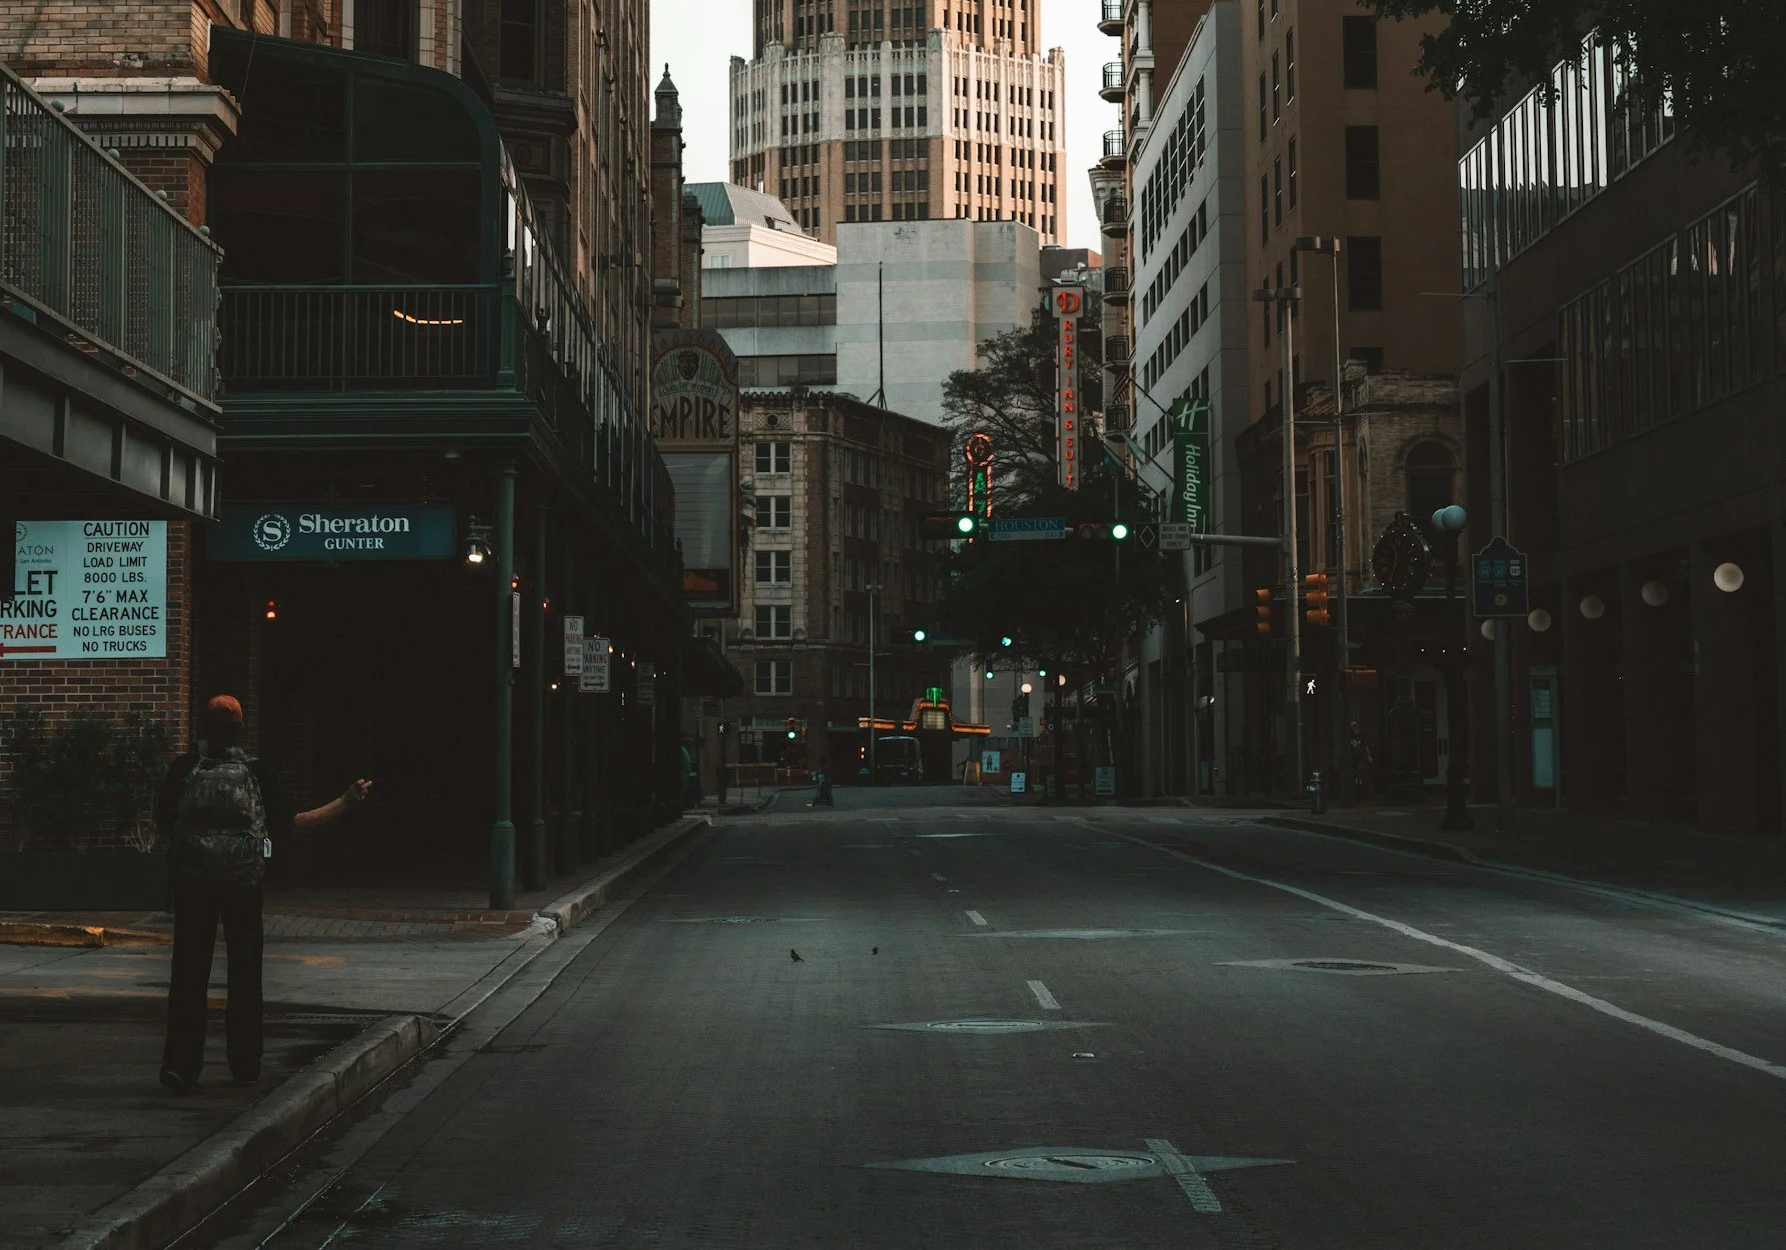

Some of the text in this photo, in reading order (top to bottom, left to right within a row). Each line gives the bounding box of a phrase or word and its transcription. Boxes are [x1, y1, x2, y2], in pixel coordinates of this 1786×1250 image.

[1056, 291, 1081, 371] DRURY
[1063, 377, 1075, 413] INN
[1064, 435, 1076, 492] SUIT
[1183, 444, 1201, 502] Holiday
[84, 522, 149, 537] CAUTION
[299, 514, 411, 534] Sheraton
[995, 518, 1058, 532] HOUSTON
[87, 542, 144, 553] DRIVEWAY
[324, 538, 385, 550] GUNTER
[18, 546, 54, 556] ATON
[83, 556, 148, 568] LOAD LIMIT
[84, 572, 147, 583] 8000 LBS.
[116, 590, 148, 603] MAX
[0, 600, 57, 619] RKING
[72, 607, 159, 621] CLEARANCE
[74, 625, 156, 637] NO LRG BUSES
[569, 620, 578, 632] NO
[82, 641, 147, 652] NO TRUCKS
[588, 642, 600, 652] NO
